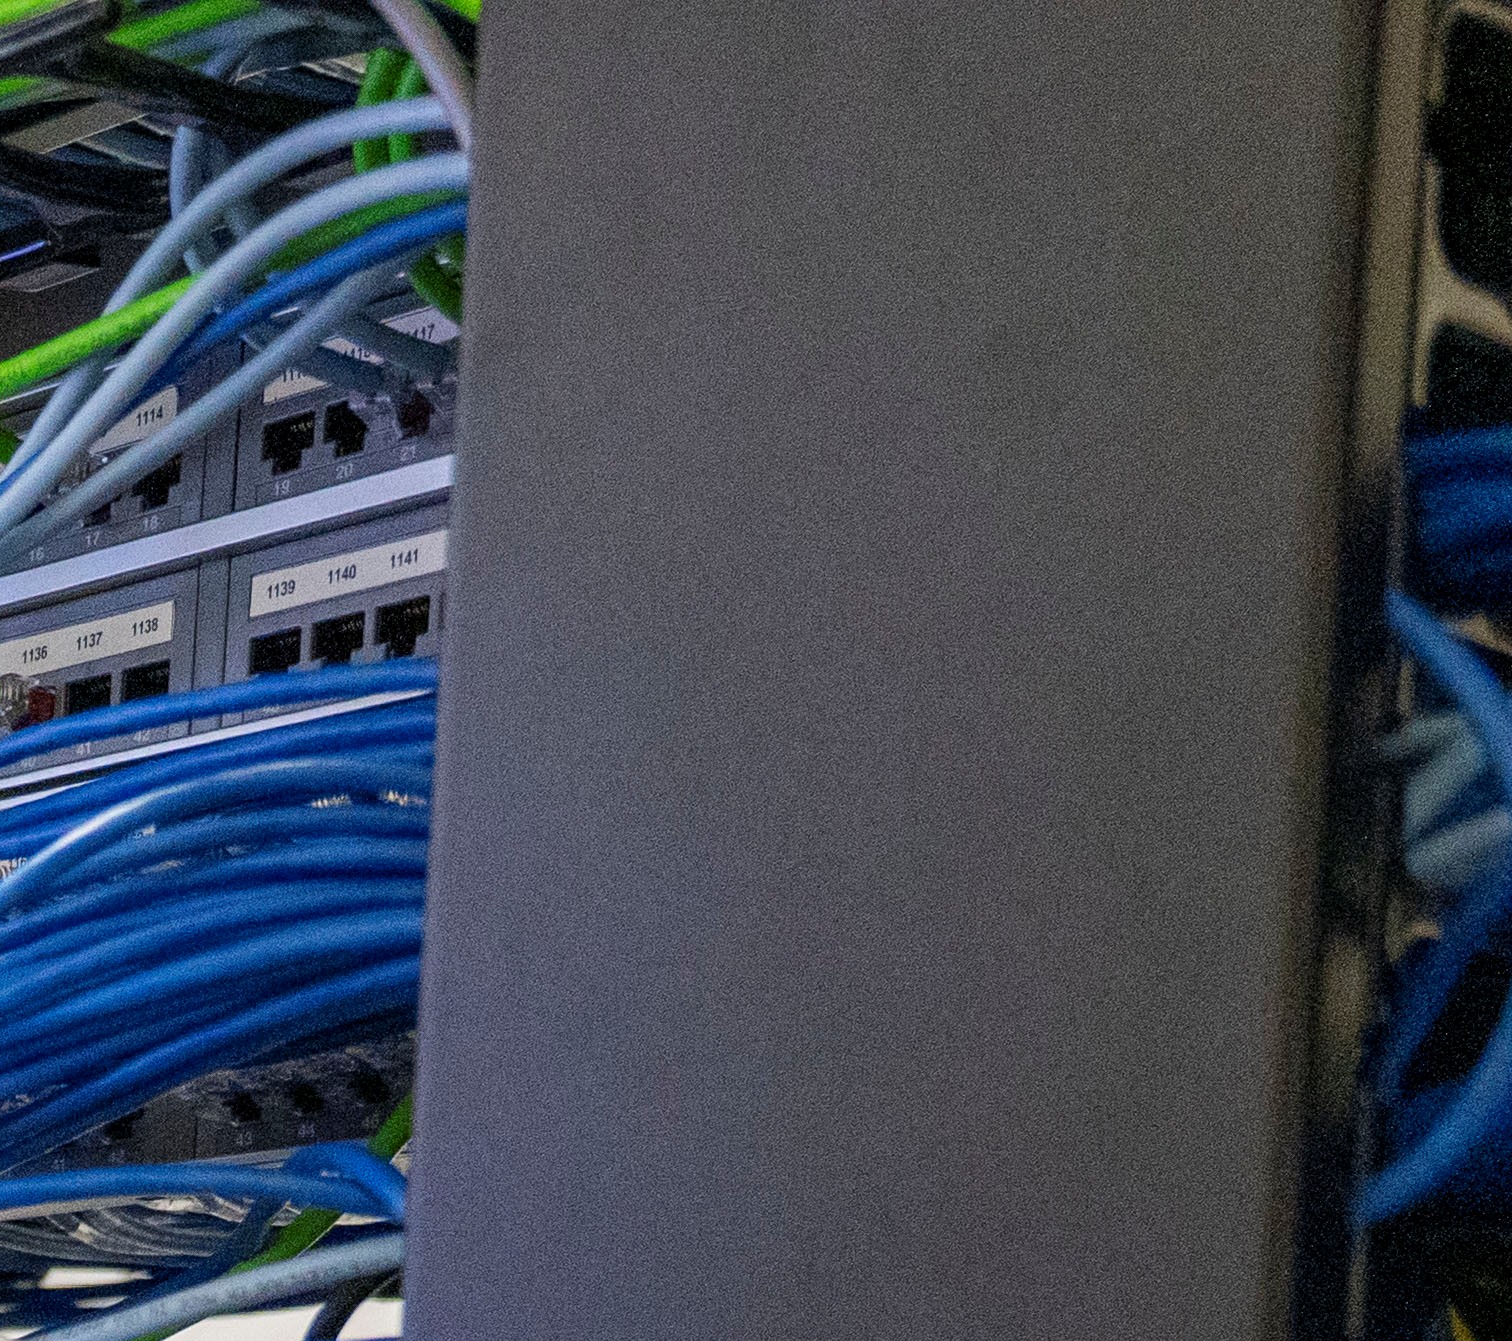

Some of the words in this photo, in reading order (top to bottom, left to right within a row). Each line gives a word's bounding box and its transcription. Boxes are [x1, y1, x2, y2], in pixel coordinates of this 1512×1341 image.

[136, 407, 164, 427] 1114
[336, 464, 353, 479] 20
[266, 579, 296, 598] 1139
[328, 563, 357, 584] 1140
[390, 548, 420, 568] 1141
[22, 646, 48, 664] 1136
[76, 632, 102, 651] 1137
[130, 618, 158, 637] 1138
